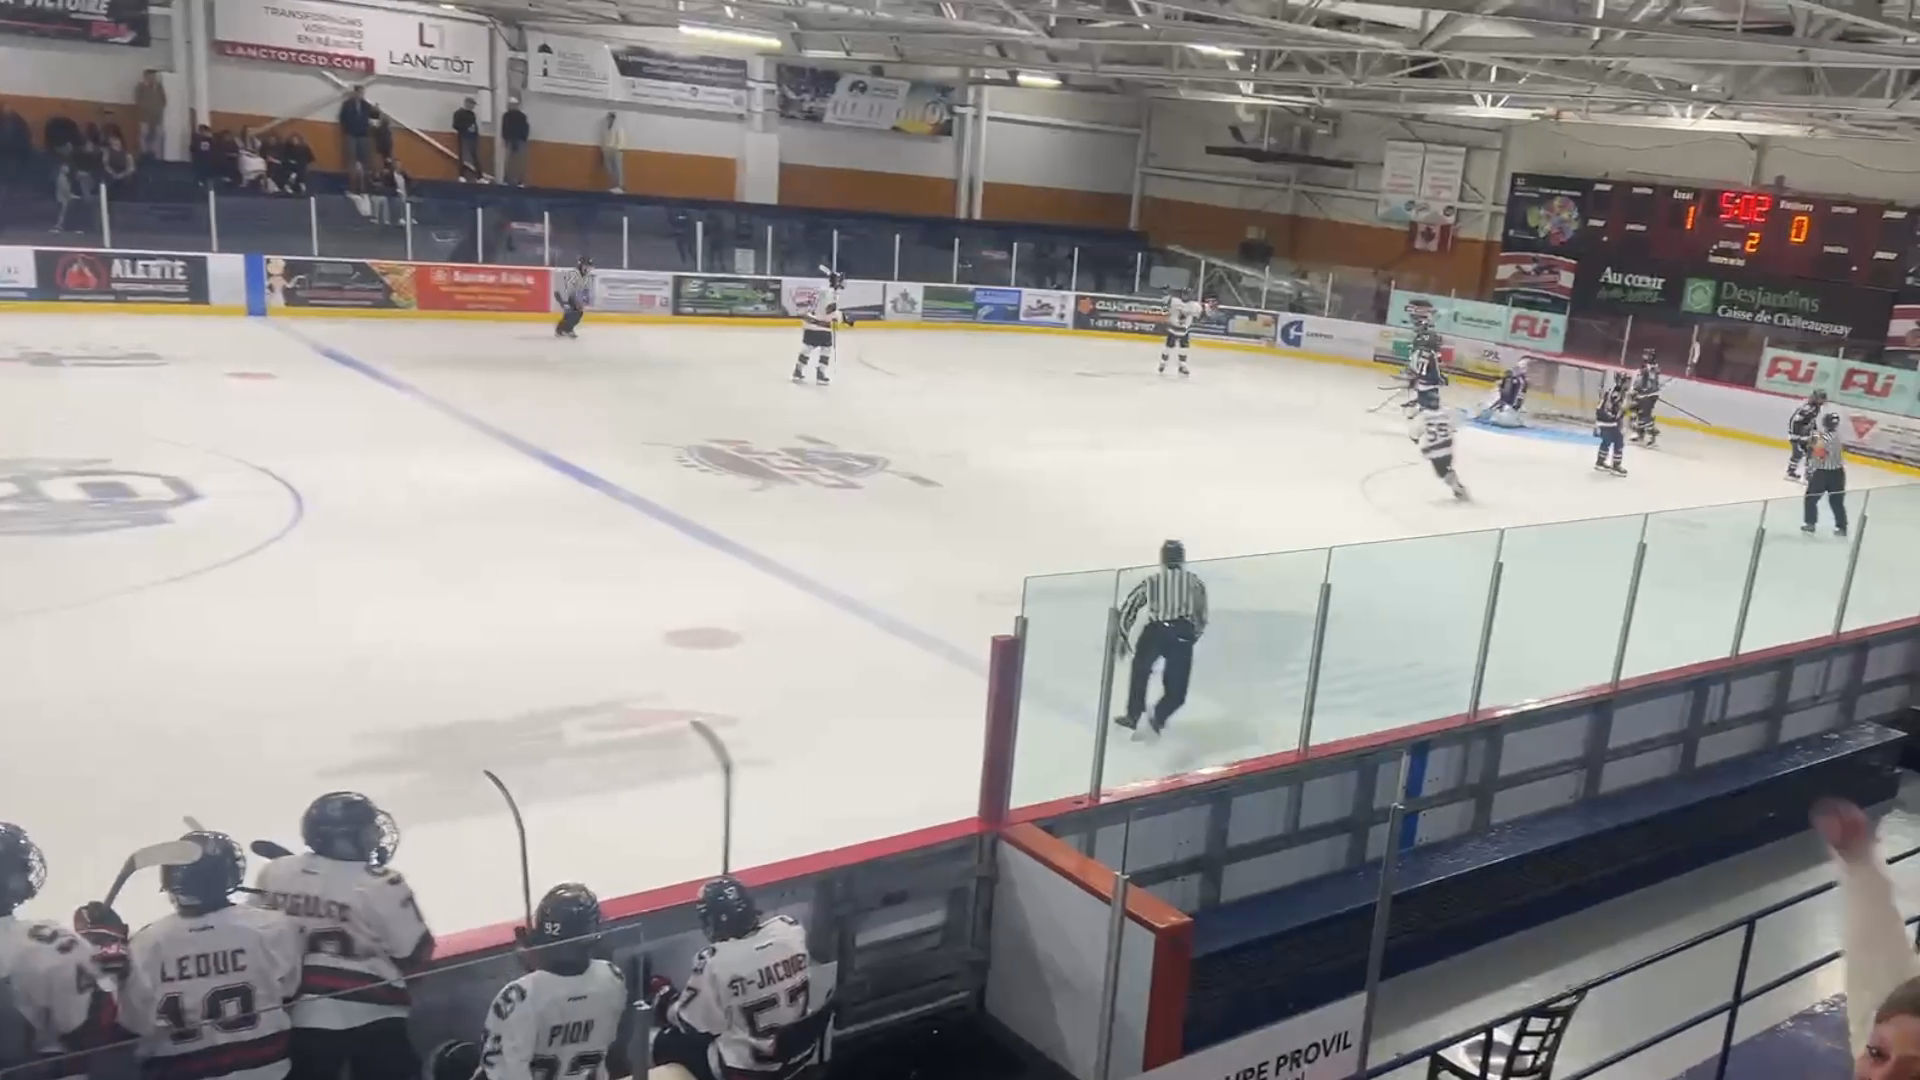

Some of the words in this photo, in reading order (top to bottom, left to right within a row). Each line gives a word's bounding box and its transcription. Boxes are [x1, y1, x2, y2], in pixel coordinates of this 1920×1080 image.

[224, 44, 367, 70] LANCTOTCSD.COM
[1685, 205, 1696, 230] 1
[1719, 191, 1770, 222] 5:02
[1745, 232, 1761, 253] 2
[1789, 216, 1809, 243] 0
[1599, 266, 1622, 285] Au
[1721, 281, 1820, 313] Desjardins
[1717, 305, 1754, 321] Caisse
[1754, 310, 1772, 324] de
[544, 921, 561, 936] 92
[160, 948, 247, 983] LEDUC
[727, 953, 808, 997] ST-JACQUE
[547, 1019, 595, 1047] PION
[1275, 1030, 1353, 1077] PROVIL
